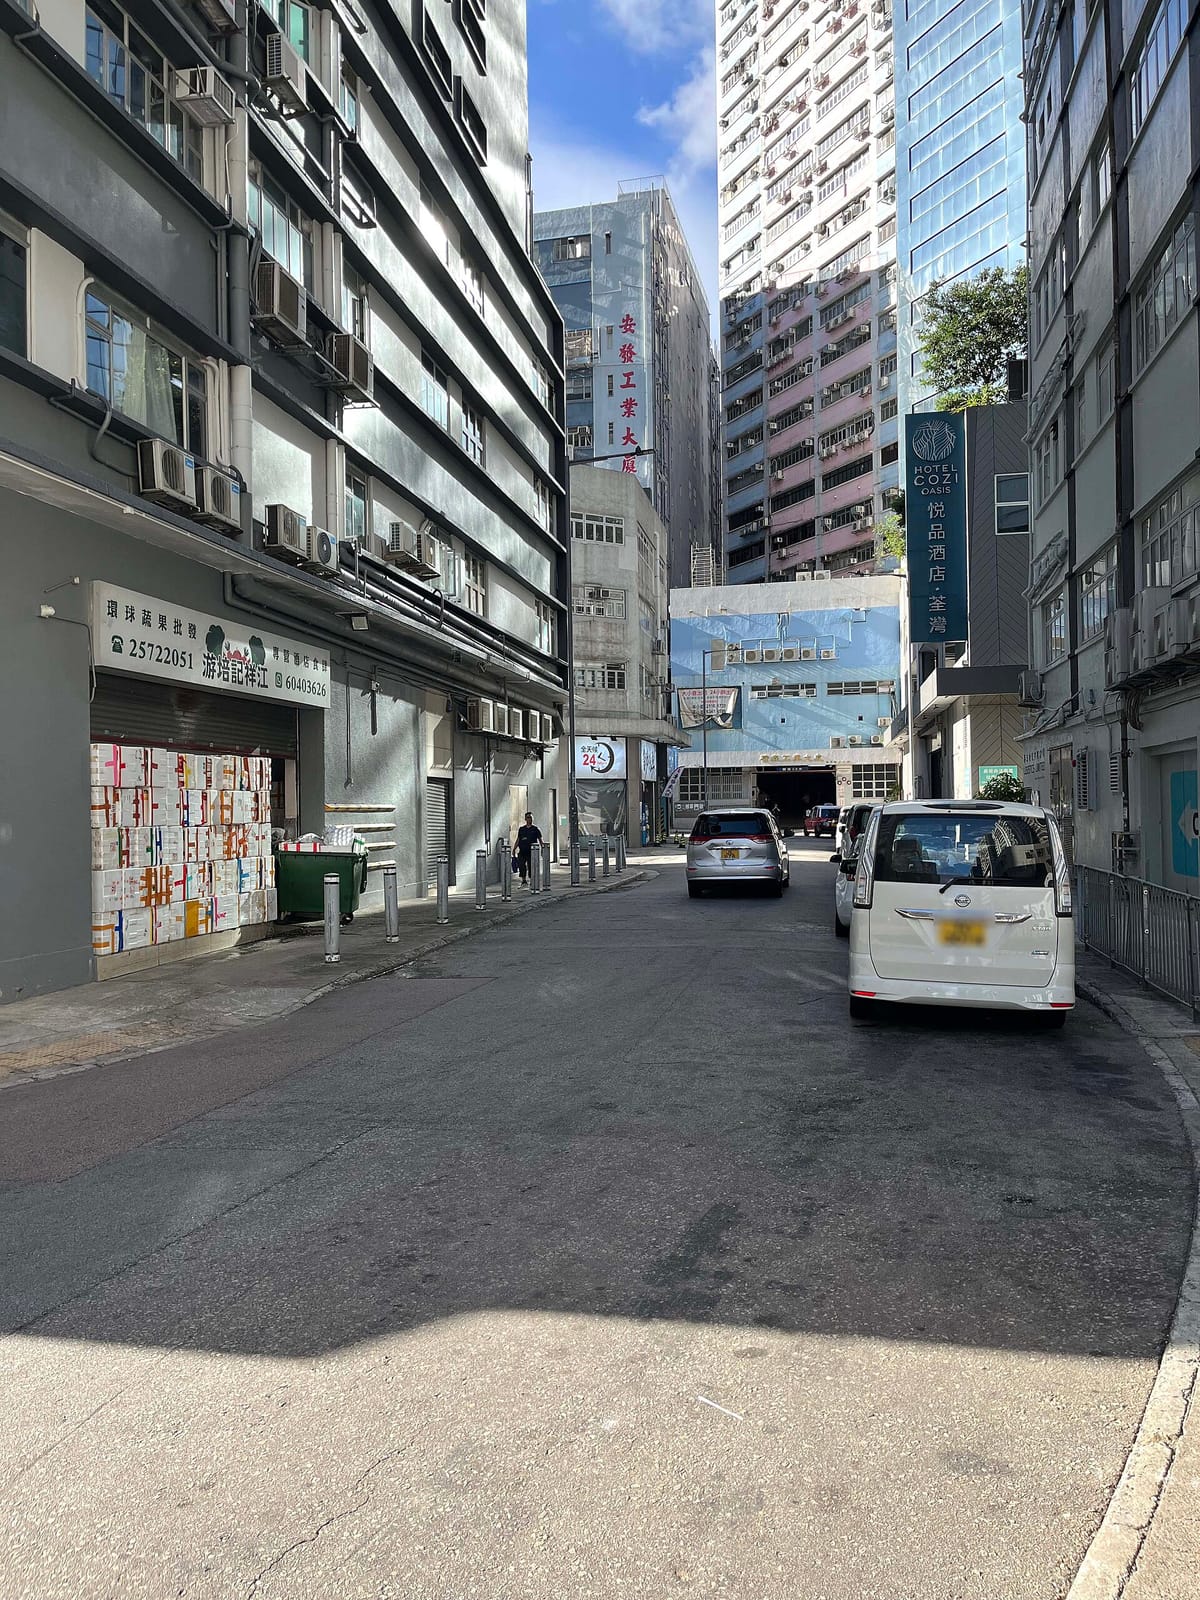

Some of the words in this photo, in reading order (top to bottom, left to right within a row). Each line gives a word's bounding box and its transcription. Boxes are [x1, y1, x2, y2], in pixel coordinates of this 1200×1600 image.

[619, 313, 638, 474] 安發工業大廈
[914, 464, 957, 474] HOTEL
[914, 473, 958, 486] COZI
[921, 486, 951, 495] OASIS
[107, 599, 197, 640] 環球蔬果批發
[129, 638, 193, 669] 25722051
[285, 675, 327, 697] 60403626
[582, 753, 596, 766] 24
